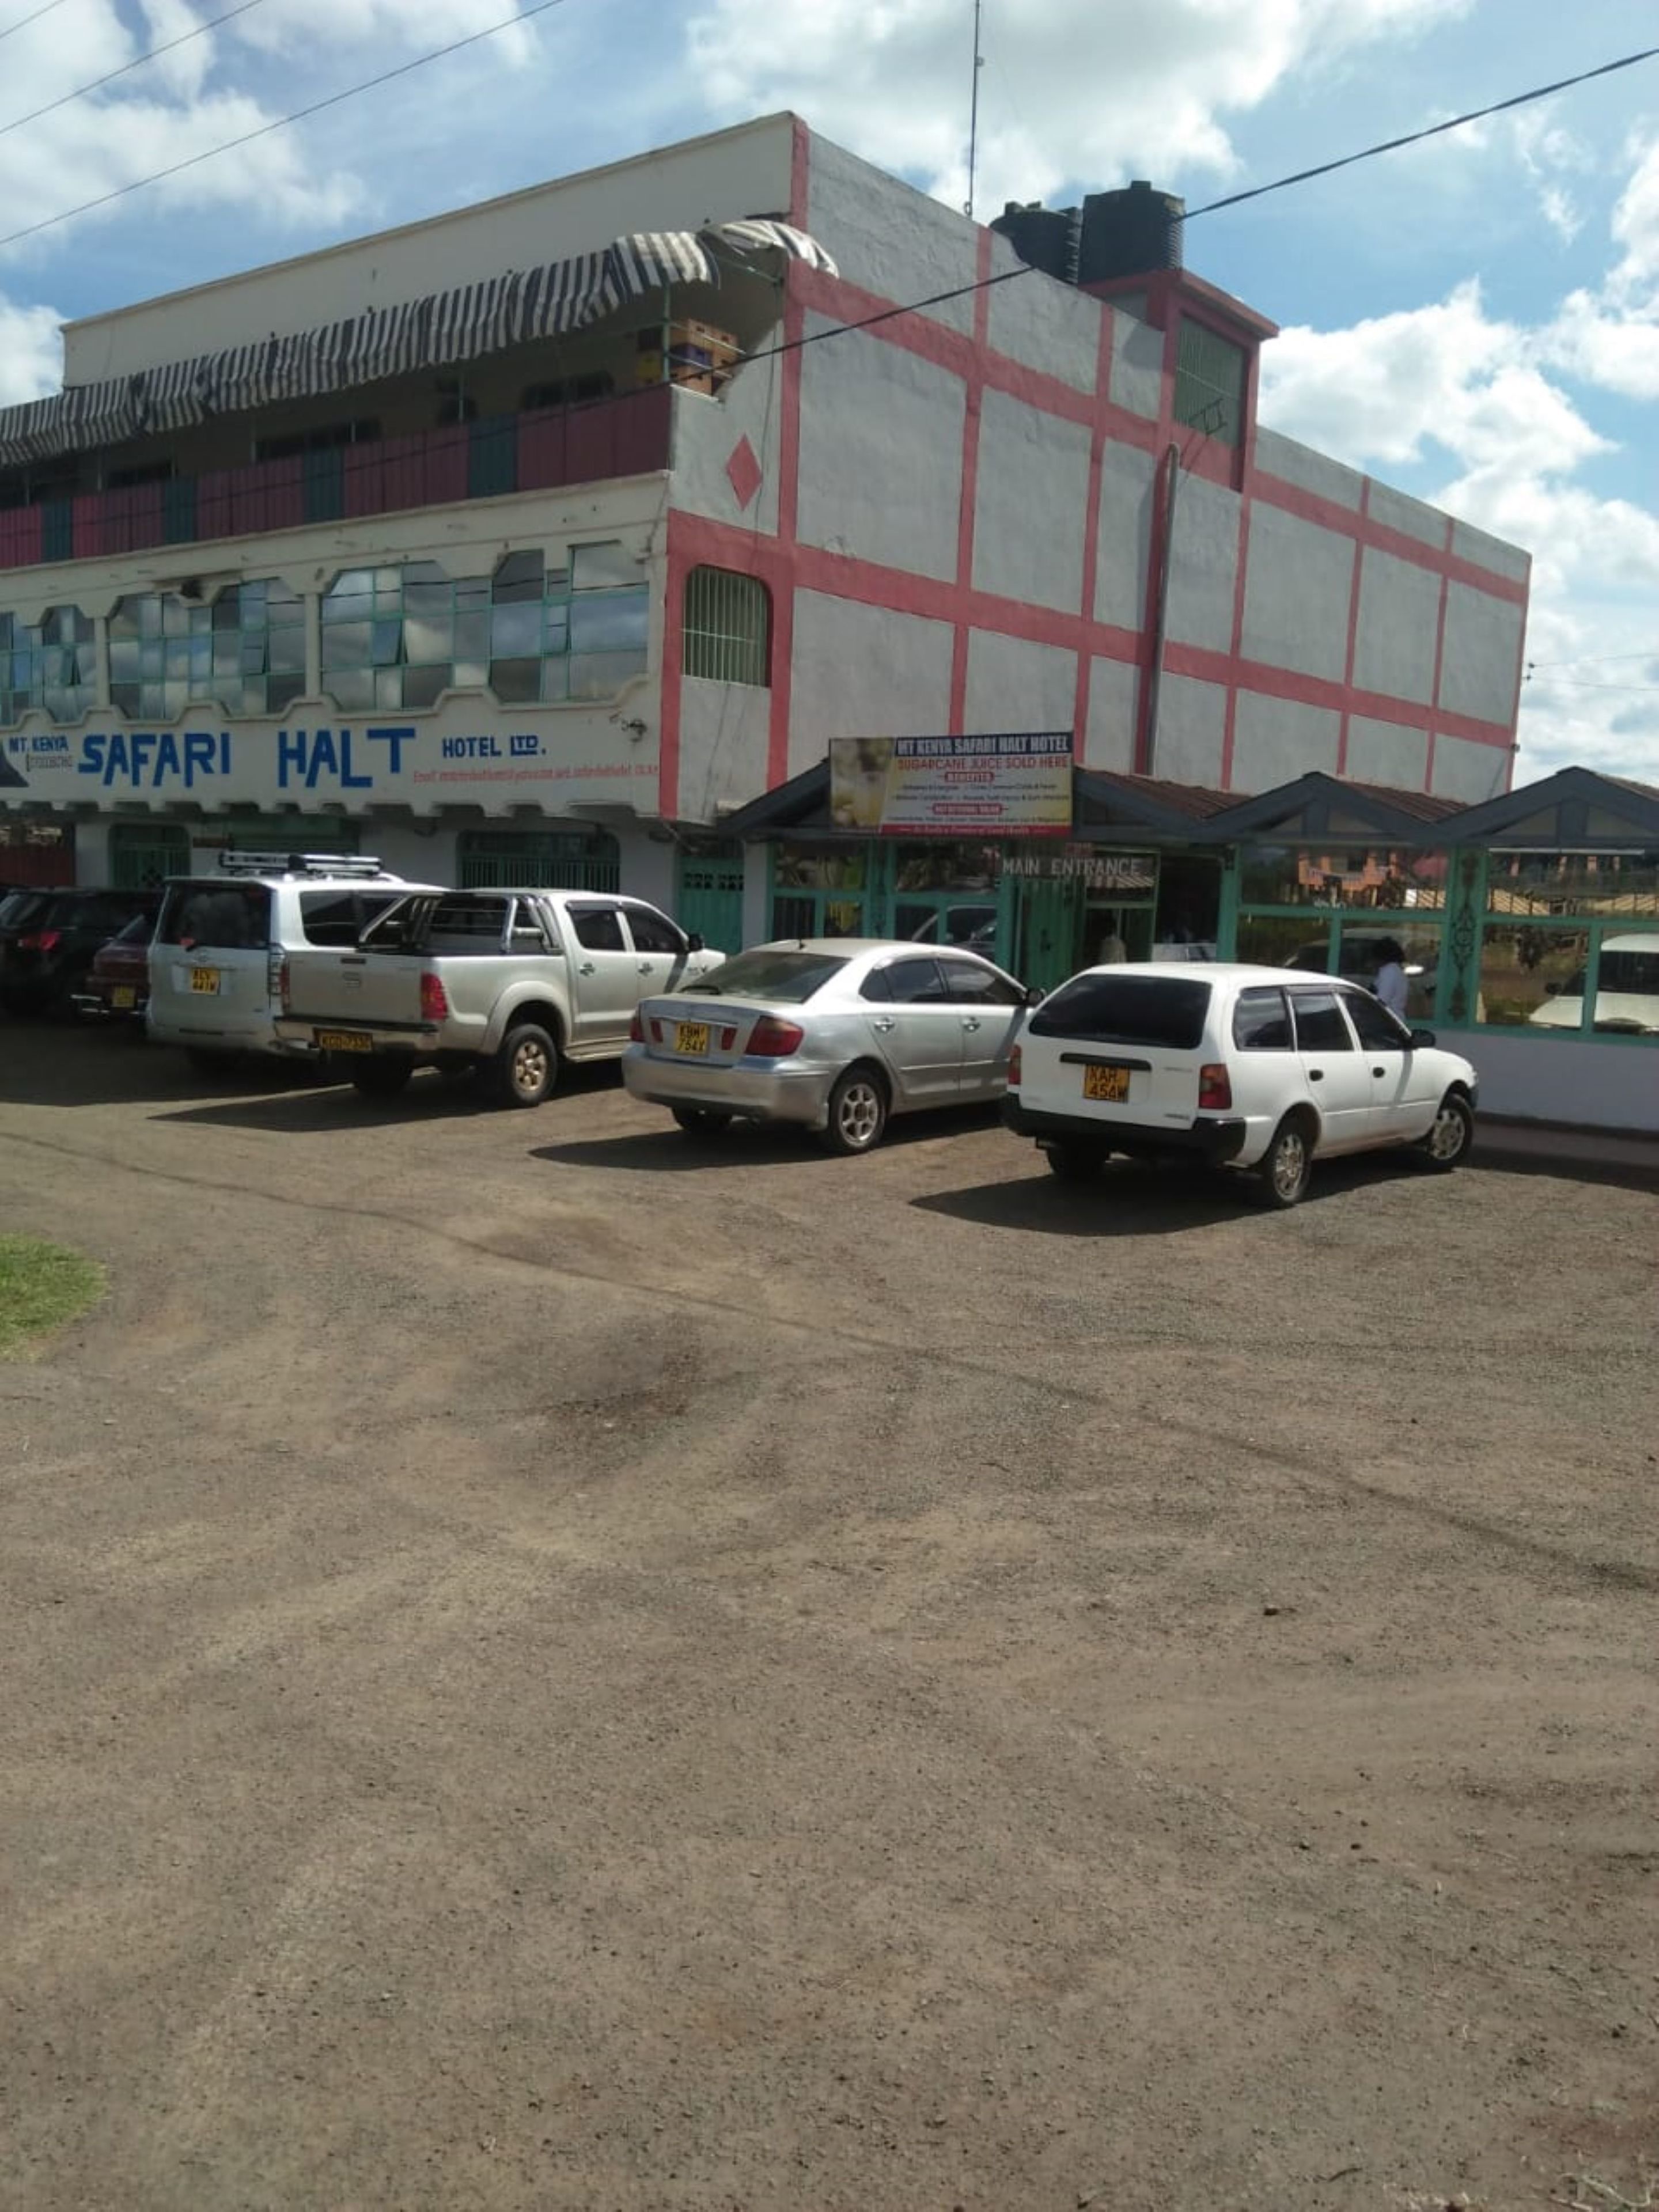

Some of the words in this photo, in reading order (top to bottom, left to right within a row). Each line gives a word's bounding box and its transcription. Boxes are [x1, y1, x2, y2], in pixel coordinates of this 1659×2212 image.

[32, 734, 69, 751] KENYA
[442, 736, 501, 759] HOTEL
[916, 739, 952, 755] KENYA
[955, 737, 996, 753] SAFARI
[999, 736, 1028, 752] HALT
[1031, 734, 1068, 751] HOTEL
[78, 732, 229, 787] SAFARI
[278, 728, 415, 788] HALT
[897, 757, 966, 770] SUGARCANE
[971, 757, 1002, 769] JUICE
[1006, 757, 1036, 768] SOLD
[1040, 756, 1068, 768] HERE
[1002, 857, 1040, 875] MAIN
[1051, 856, 1140, 876] ENTRANCE
